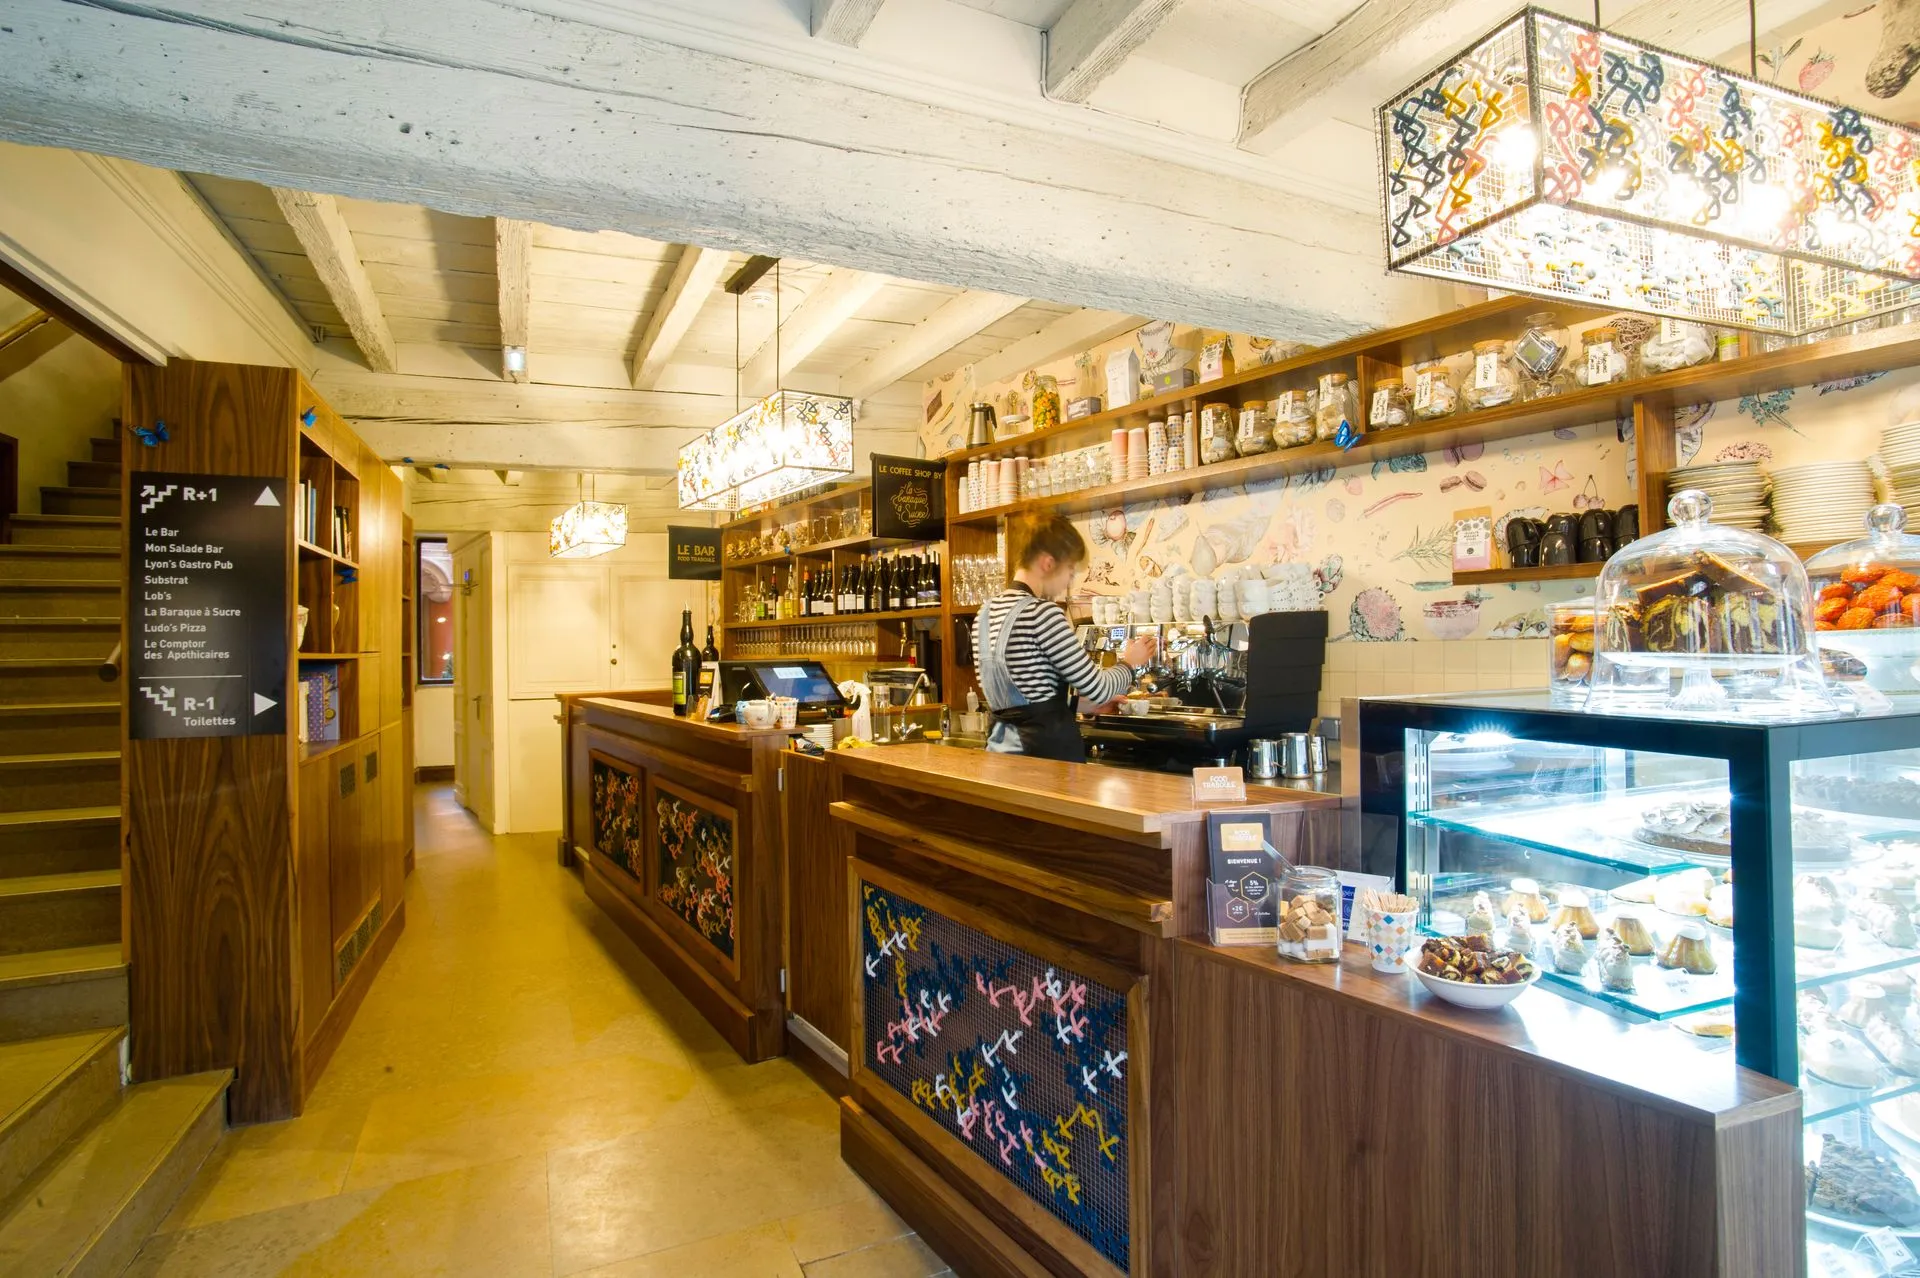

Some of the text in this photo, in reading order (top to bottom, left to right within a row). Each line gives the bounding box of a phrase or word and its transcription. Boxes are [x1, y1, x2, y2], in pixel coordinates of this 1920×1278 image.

[879, 465, 887, 473] LE
[890, 466, 912, 476] COFFEE
[915, 469, 931, 478] SHOP
[183, 487, 217, 502] R+1
[145, 527, 179, 537] Le Bar
[145, 543, 224, 554] Mon Salade Bar
[678, 544, 716, 557] LE BAR
[145, 559, 233, 571] Lyon's Gastro Pub
[144, 575, 189, 585] Substrat
[144, 591, 172, 601] Lob's
[144, 606, 241, 618] La Baraque à Sucre
[144, 623, 207, 633] Ludo's Pizza
[144, 639, 206, 650] Le Comptoir
[144, 649, 230, 660] des Apothicaires
[184, 697, 215, 711] R-1
[184, 716, 236, 727] Toilettes
